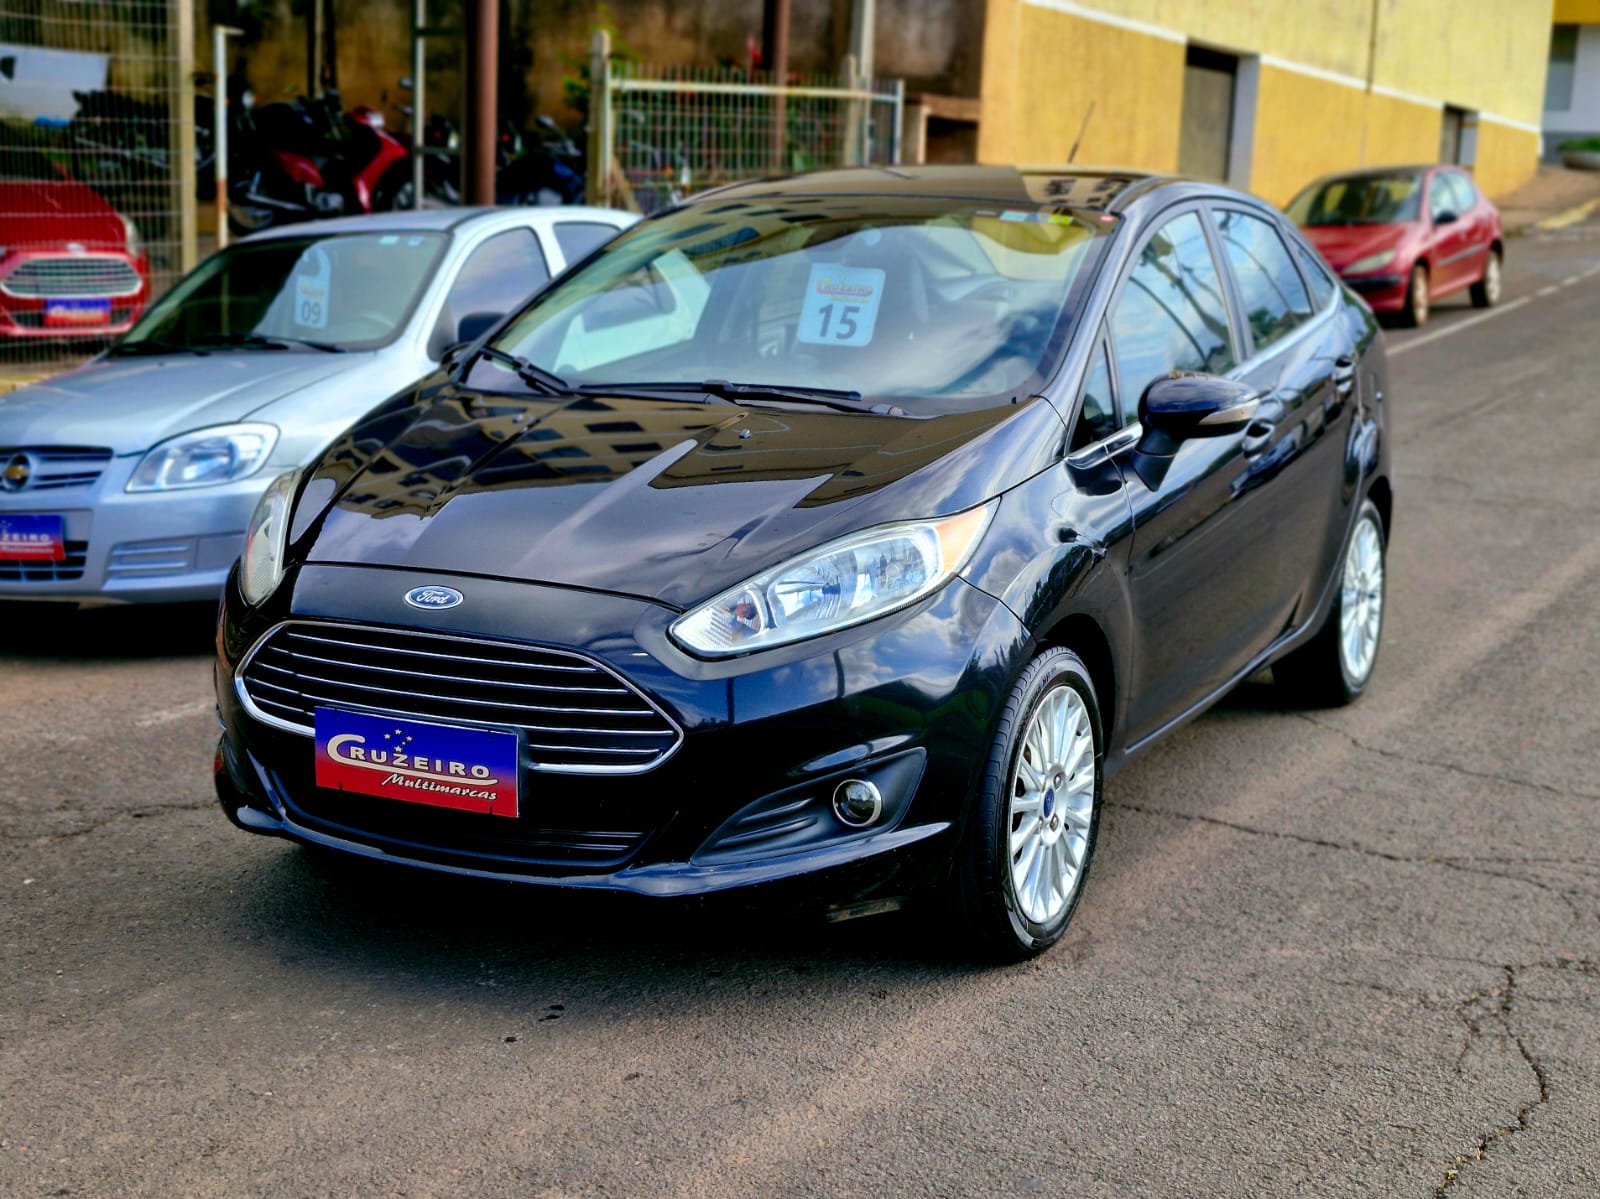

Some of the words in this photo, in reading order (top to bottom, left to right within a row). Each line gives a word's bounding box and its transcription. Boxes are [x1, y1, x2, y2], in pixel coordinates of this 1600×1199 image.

[301, 300, 321, 324] 09
[819, 303, 860, 340] 15
[416, 590, 450, 604] Ford
[327, 733, 498, 786] CRUZEIRO
[381, 773, 497, 800] Multimarcas
